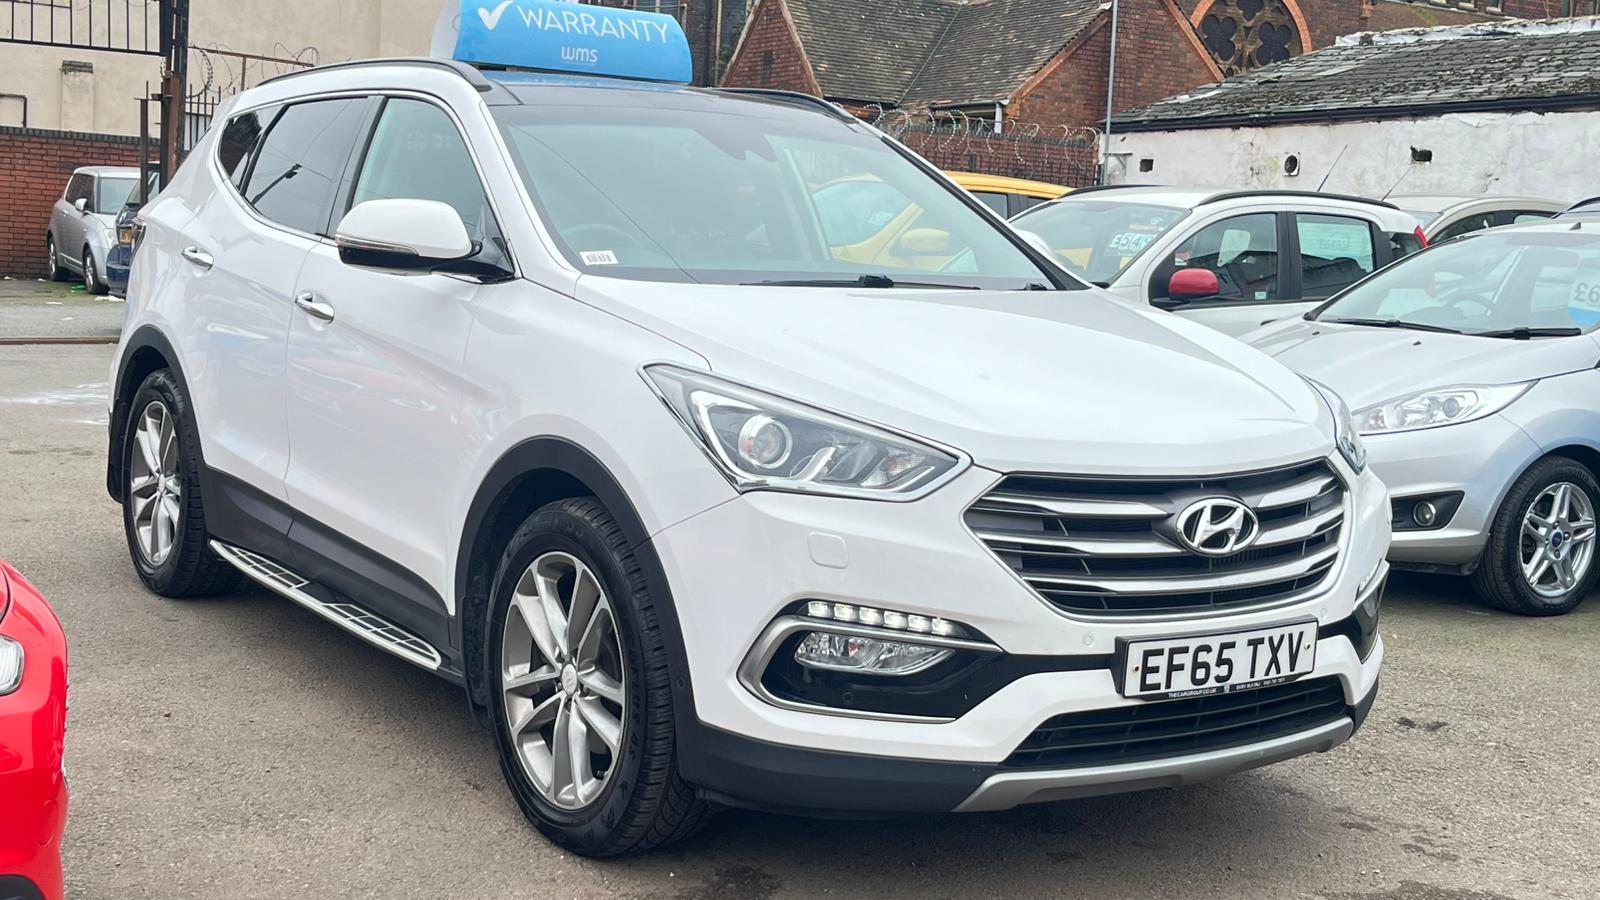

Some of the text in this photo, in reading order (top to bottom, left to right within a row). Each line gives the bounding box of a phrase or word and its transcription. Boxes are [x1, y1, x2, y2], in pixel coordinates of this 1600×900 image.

[516, 4, 667, 44] WARRANTY
[561, 46, 598, 63] wms
[1139, 631, 1304, 692] EF65 TXV
